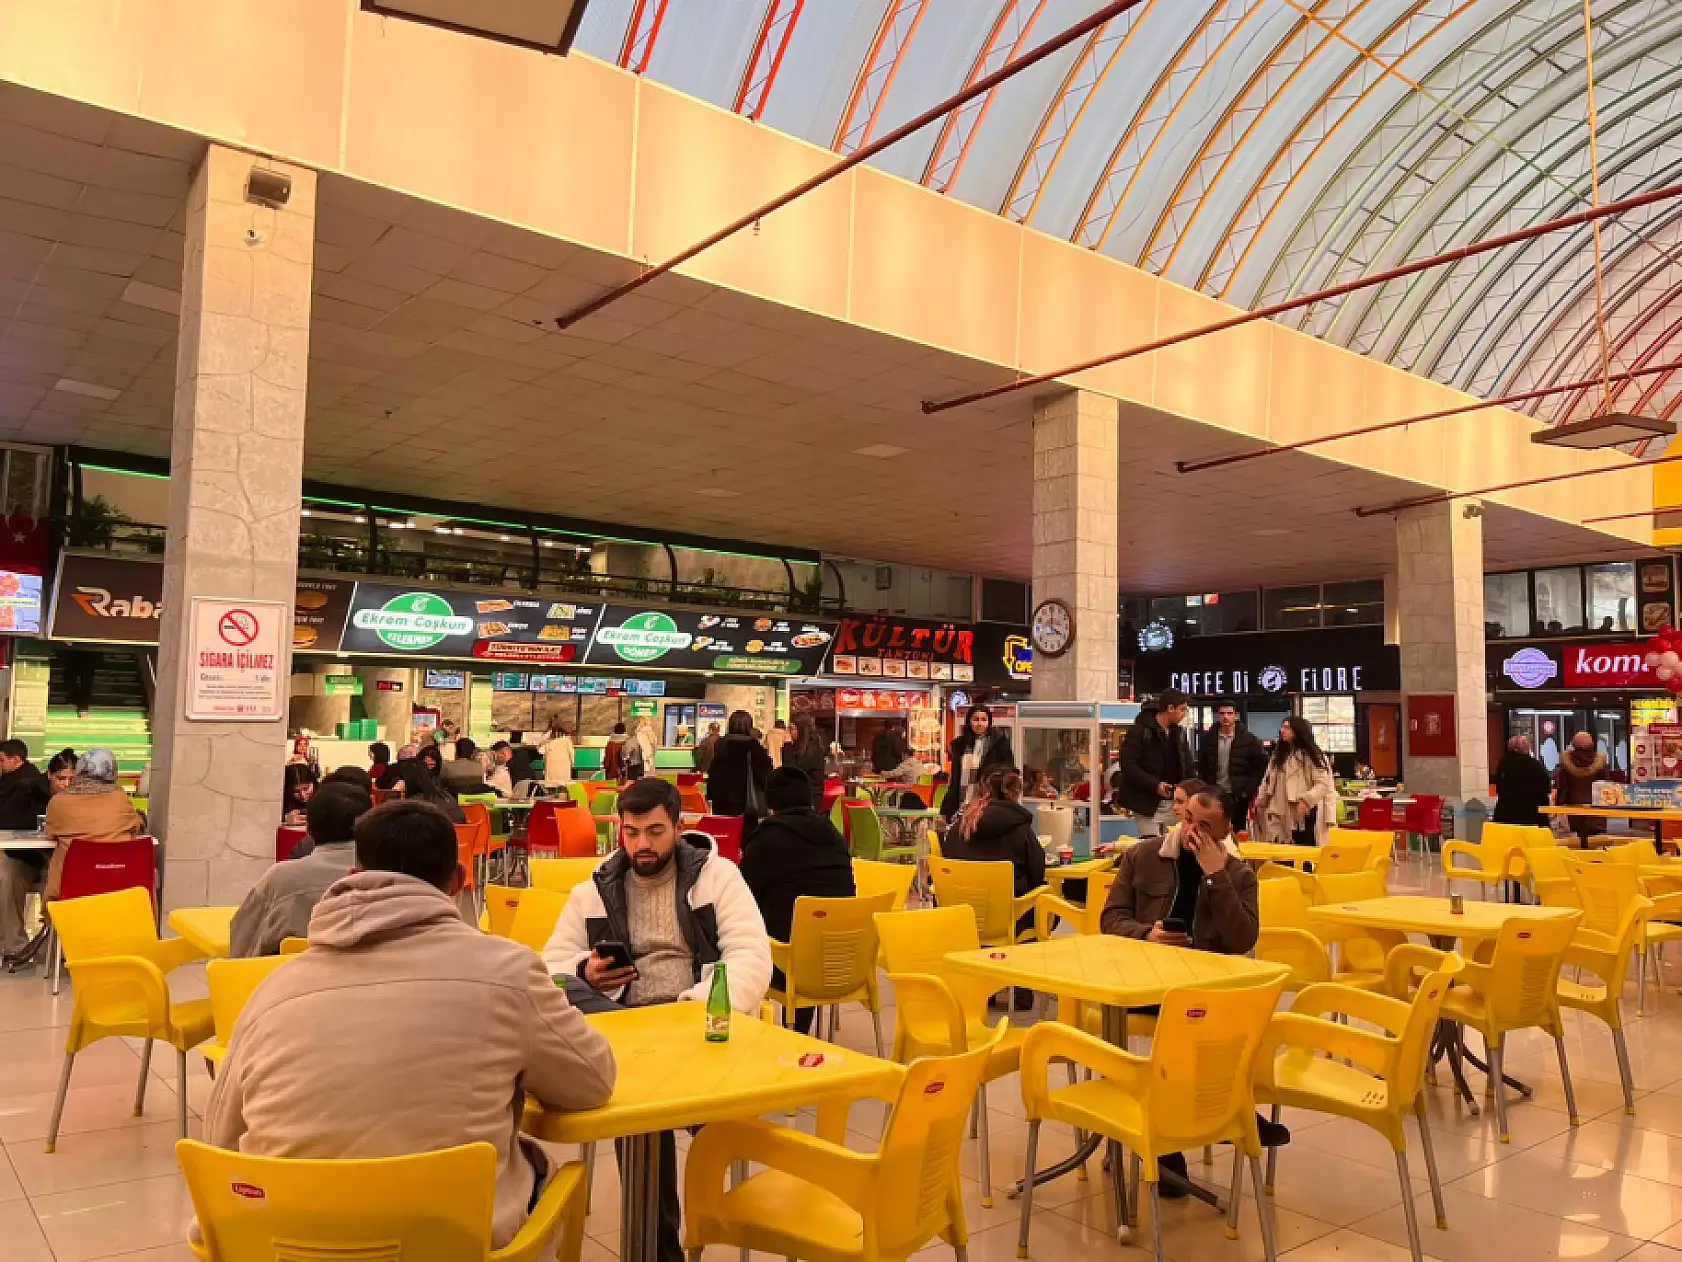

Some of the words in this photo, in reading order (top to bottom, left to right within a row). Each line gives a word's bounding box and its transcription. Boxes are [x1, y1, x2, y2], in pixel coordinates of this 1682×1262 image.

[361, 611, 408, 627] Ekrem
[413, 615, 467, 630] Coşkun
[603, 630, 641, 641] Ekrem
[835, 616, 974, 664] KÜLTÜR
